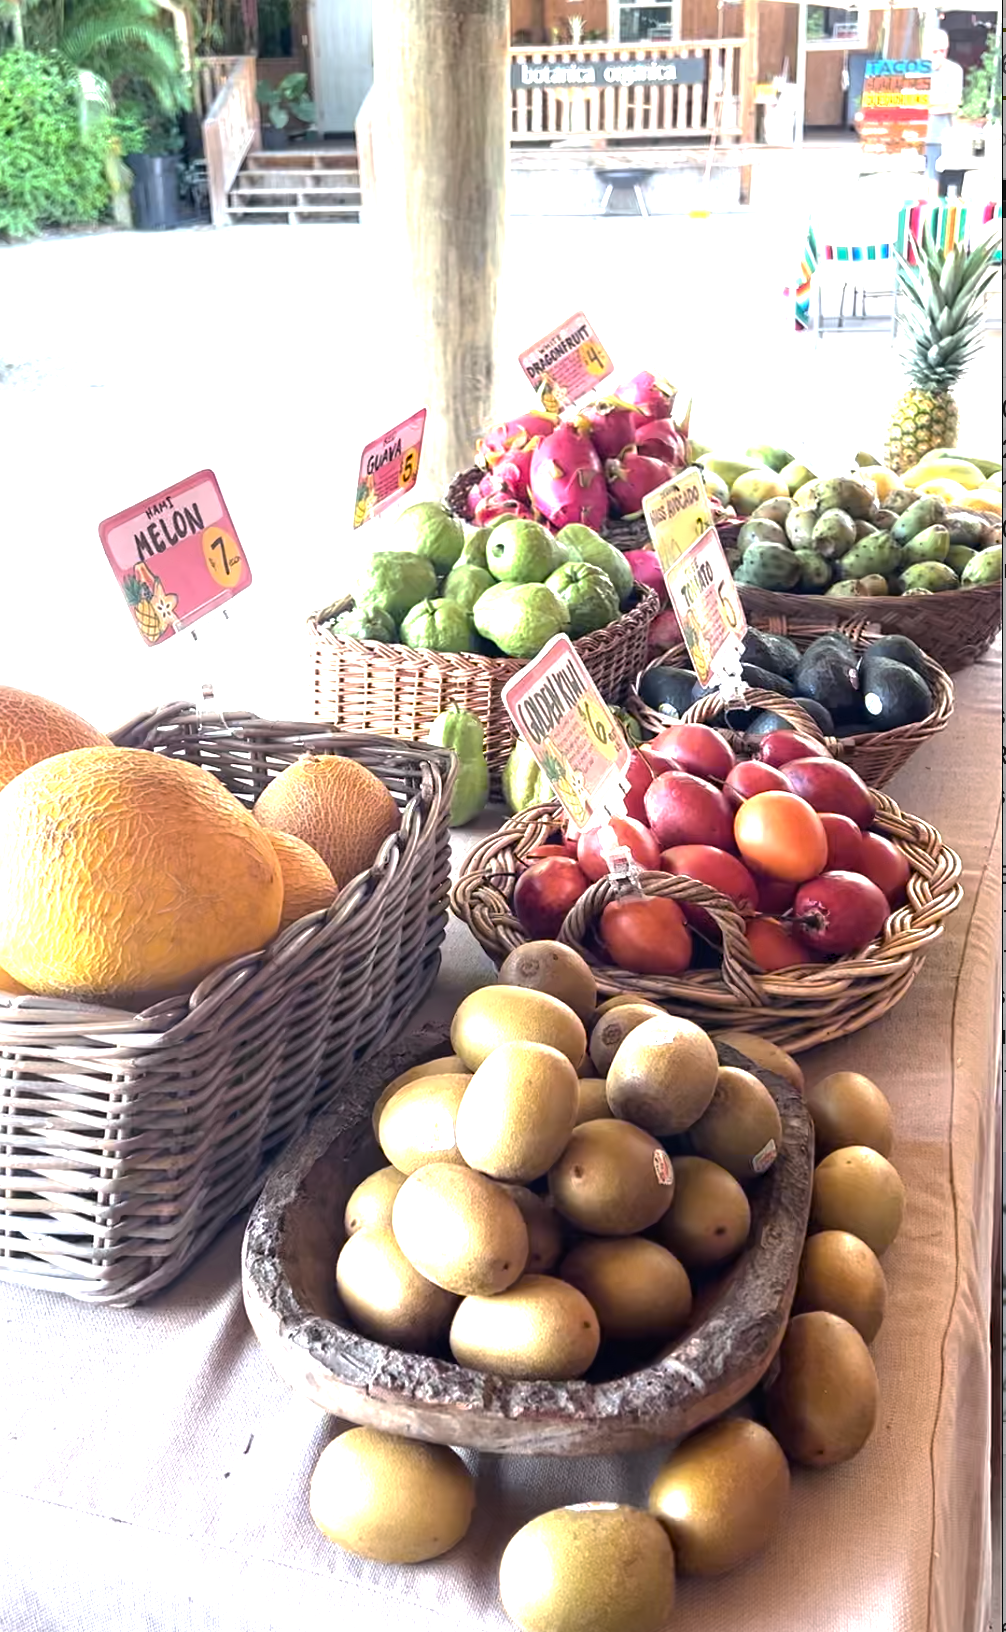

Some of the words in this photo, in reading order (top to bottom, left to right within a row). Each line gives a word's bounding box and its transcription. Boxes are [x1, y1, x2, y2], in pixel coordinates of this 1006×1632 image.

[521, 63, 596, 84] botanica
[603, 61, 677, 86] organica
[867, 59, 932, 75] TACOS
[526, 324, 589, 378] DRAGONFRUIT
[367, 438, 402, 475] GUAVA
[145, 496, 174, 519] HAMI
[134, 503, 204, 562] MELON
[518, 676, 566, 744] GOLDEN
[552, 659, 588, 709] KIWI
